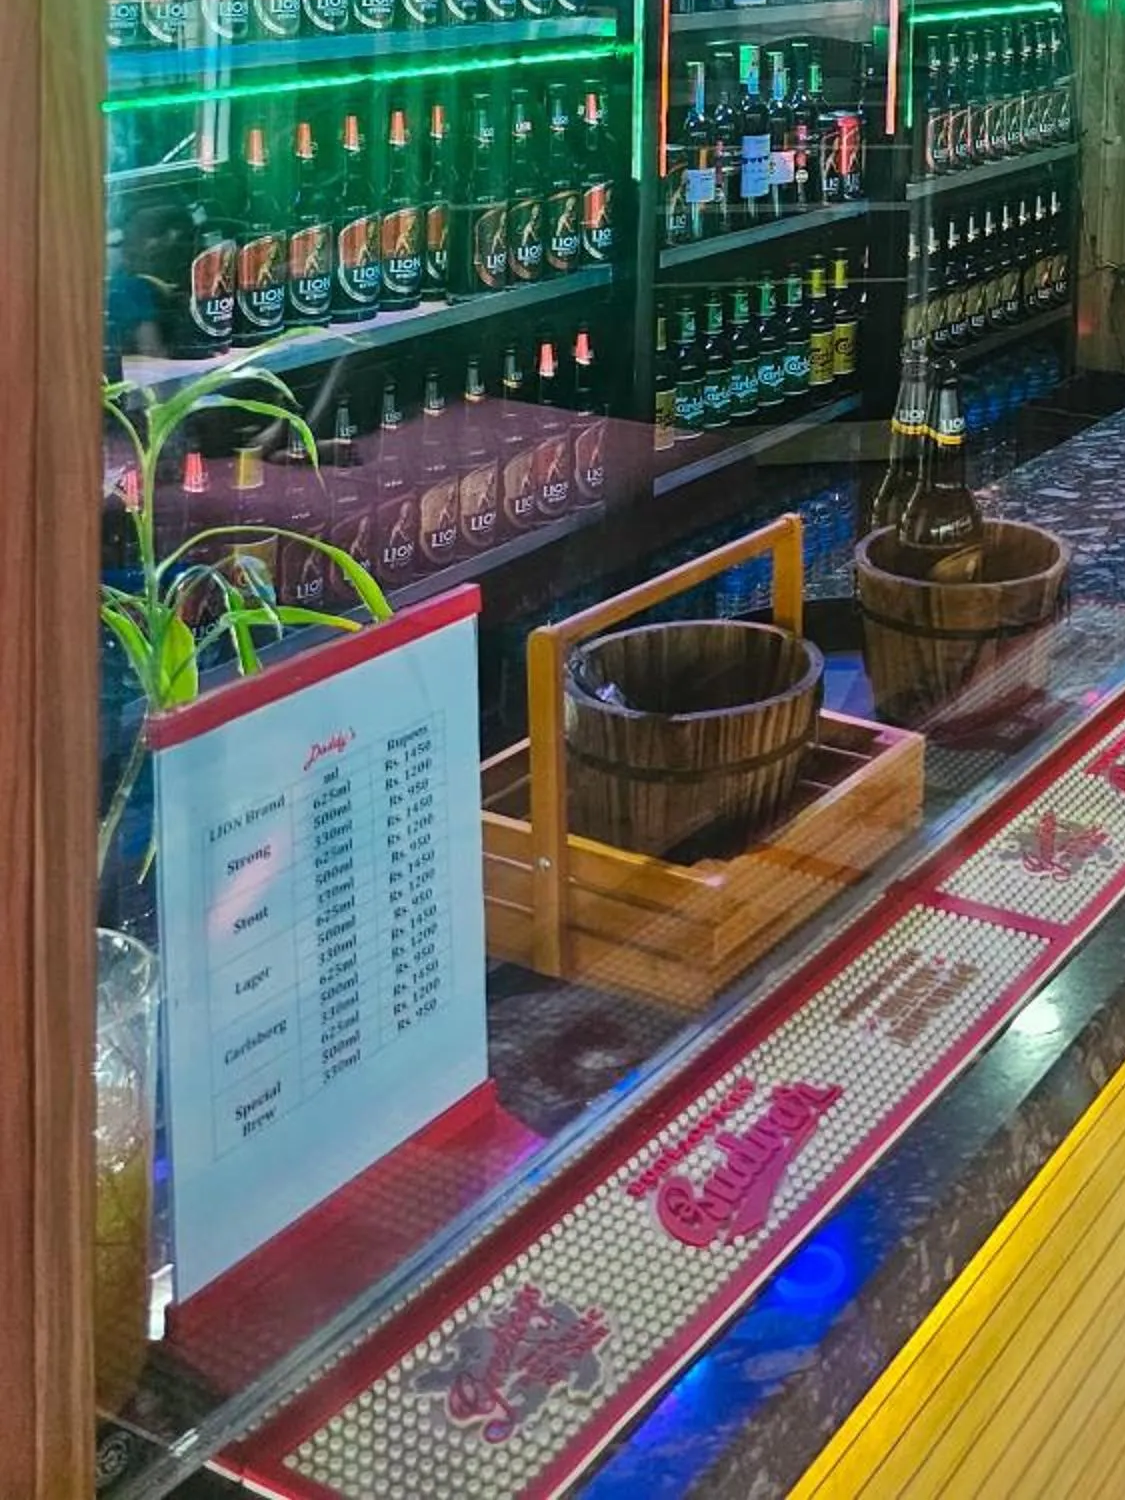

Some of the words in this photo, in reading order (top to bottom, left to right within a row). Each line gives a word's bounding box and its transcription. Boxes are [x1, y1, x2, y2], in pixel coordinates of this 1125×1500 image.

[246, 794, 286, 827] Brand
[226, 845, 272, 876] Strong
[233, 906, 269, 935] Stout
[235, 966, 271, 996] Lager
[235, 1080, 282, 1122] Special
